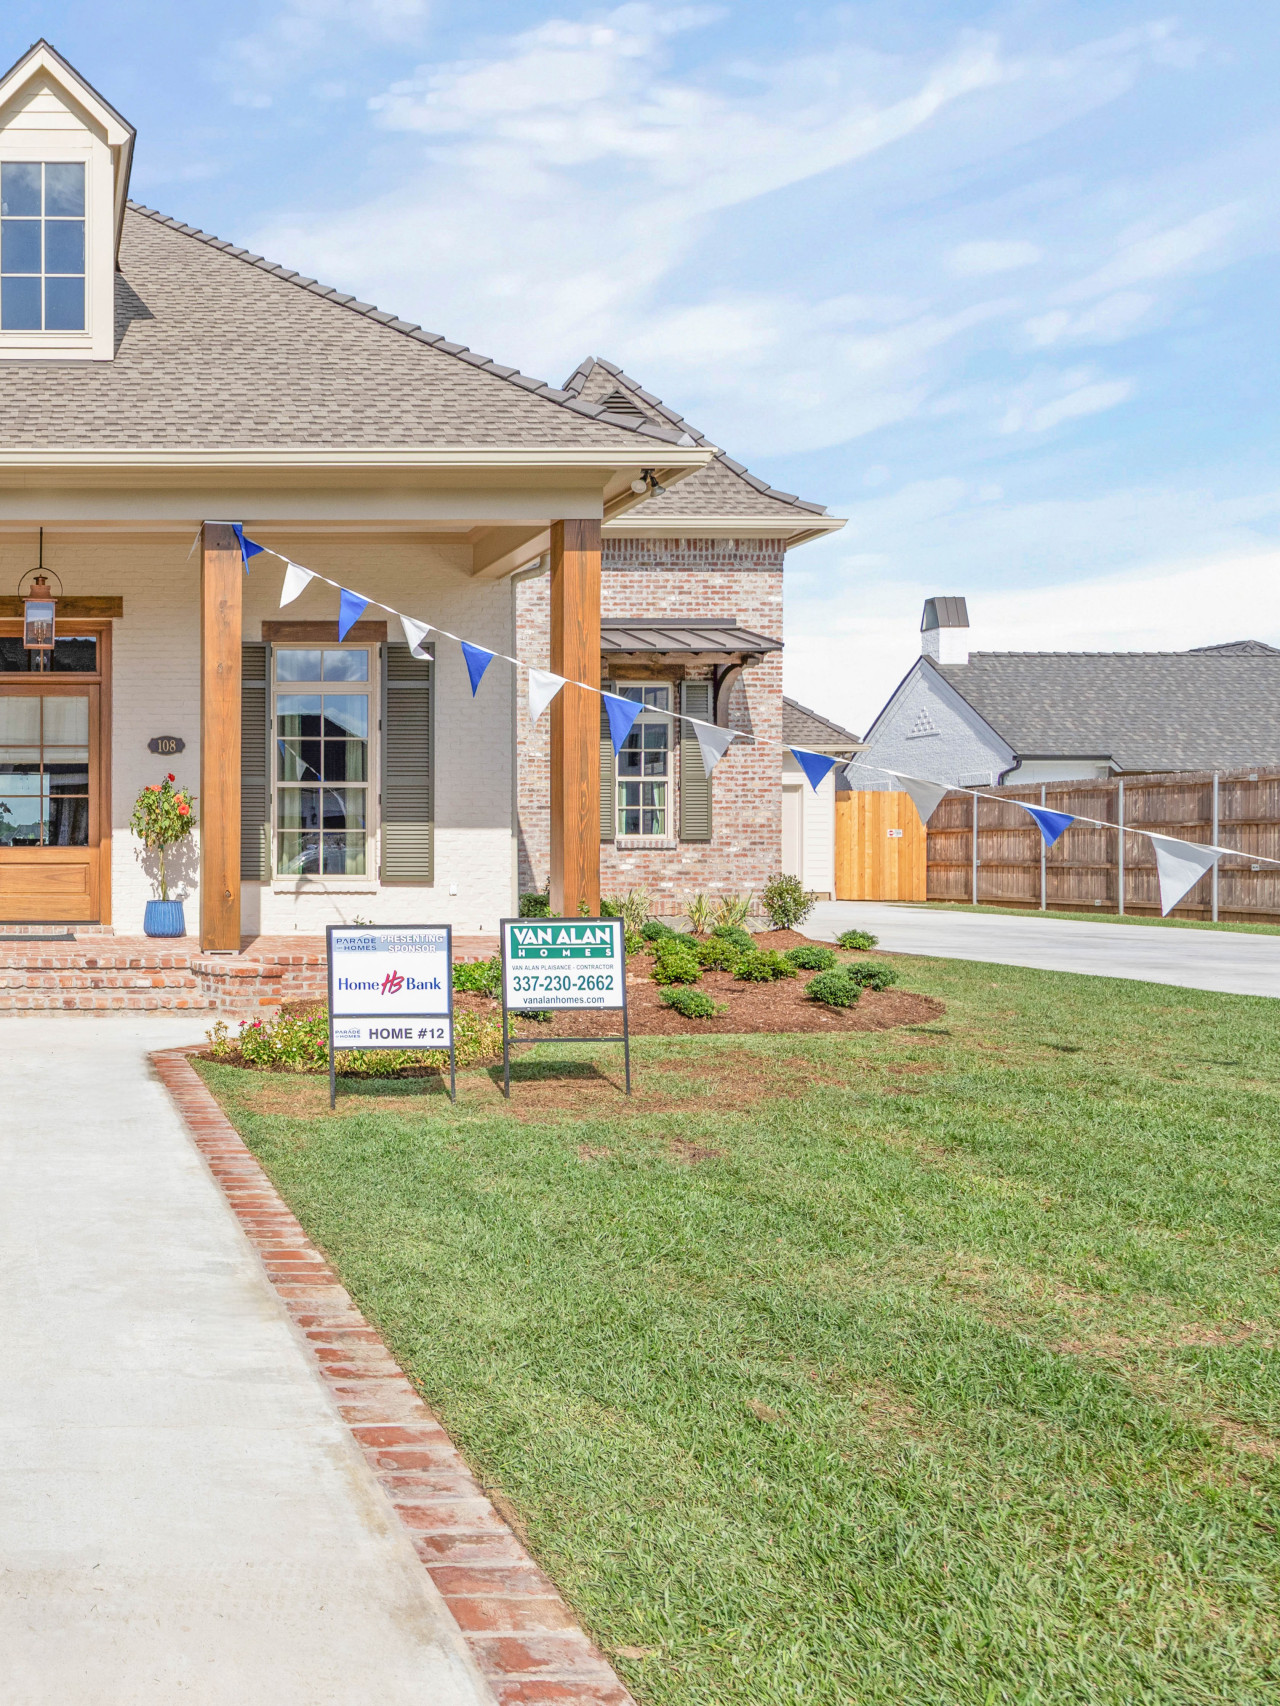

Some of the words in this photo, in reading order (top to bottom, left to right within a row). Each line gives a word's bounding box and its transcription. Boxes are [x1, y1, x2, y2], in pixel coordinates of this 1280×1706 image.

[158, 740, 176, 752] 108
[380, 934, 443, 943] PRESENTING
[513, 928, 552, 944] VAN
[556, 927, 610, 944] ALAN
[388, 944, 436, 953] SPONSOR
[518, 948, 612, 957] HOMES
[338, 978, 379, 991] Home
[406, 977, 441, 990] Bank
[513, 975, 614, 991] 337-230-2662
[523, 996, 605, 1004] vanalanhomes.com
[369, 1028, 413, 1039] HOME
[418, 1028, 444, 1039] #12
